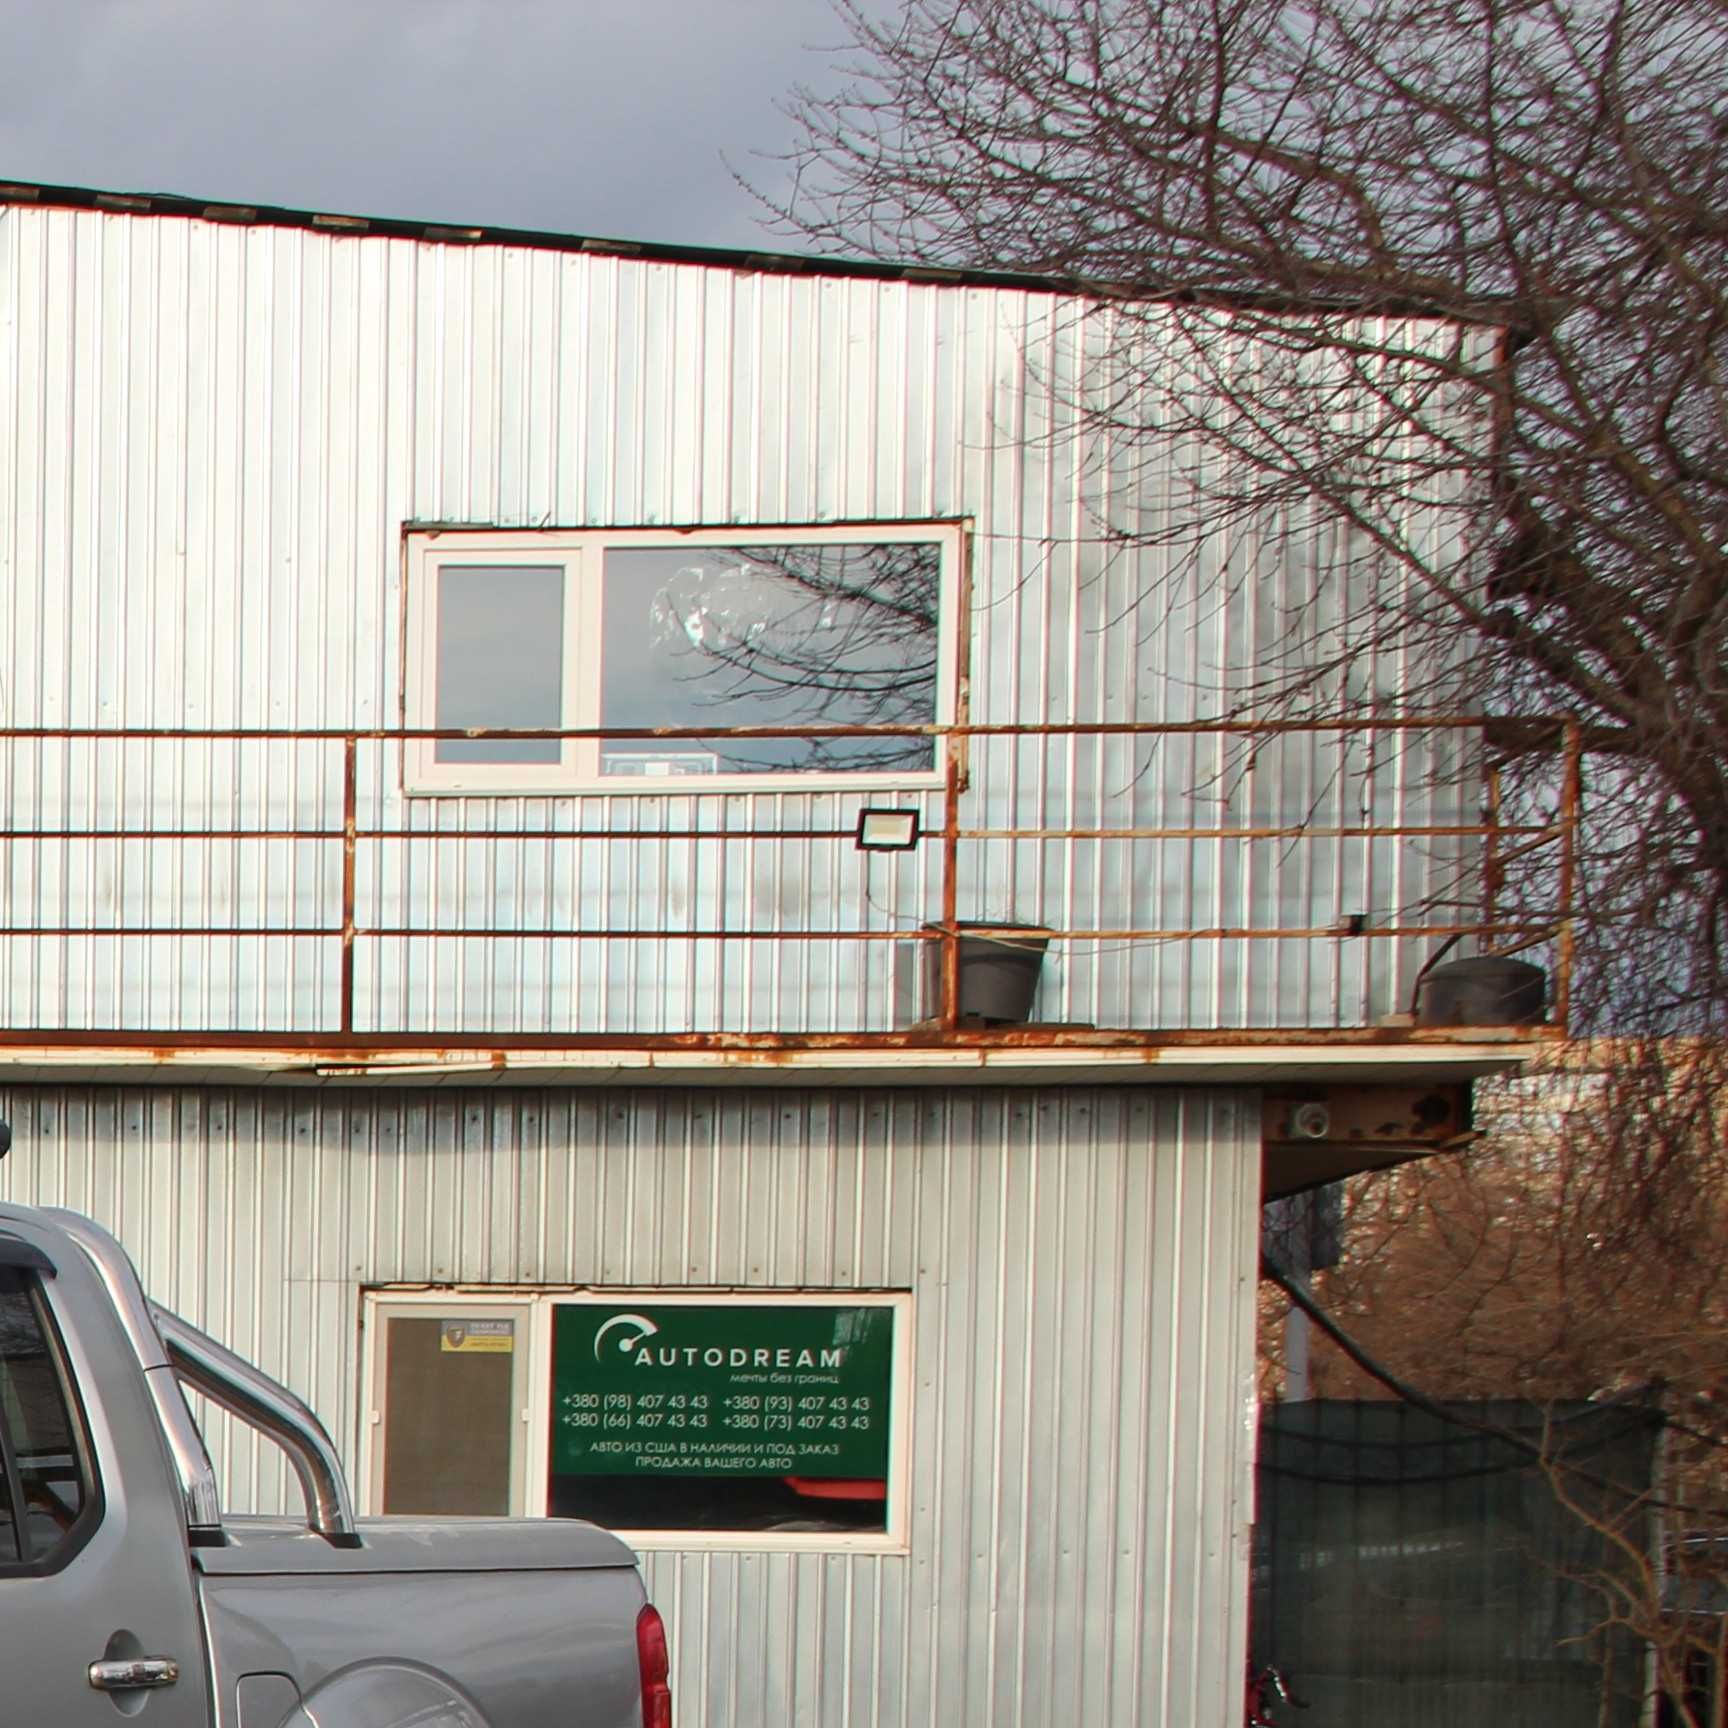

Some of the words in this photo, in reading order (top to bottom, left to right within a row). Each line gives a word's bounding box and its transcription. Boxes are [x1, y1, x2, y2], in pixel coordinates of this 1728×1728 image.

[634, 1348, 842, 1368] AUTODREAM
[730, 1374, 768, 1383] мечты
[770, 1372, 793, 1383] без
[794, 1374, 840, 1385] границ
[562, 1394, 599, 1408] +380
[603, 1394, 632, 1410] (98)
[636, 1394, 664, 1408] 407
[667, 1394, 686, 1408] 43
[689, 1394, 708, 1408] 43
[723, 1396, 760, 1410] +380
[764, 1396, 793, 1412] (93)
[797, 1396, 825, 1410] 407
[828, 1396, 848, 1410] 43
[851, 1396, 870, 1410] 43
[562, 1413, 599, 1427] +380
[603, 1413, 631, 1429] (66)
[636, 1413, 663, 1427] 407
[667, 1413, 686, 1427] 43
[689, 1413, 708, 1427] 43
[722, 1415, 760, 1429] +380
[763, 1415, 792, 1431] (73)
[797, 1415, 824, 1429] 407
[828, 1415, 847, 1429] 43
[850, 1415, 870, 1429] 43
[590, 1442, 623, 1453] АВТО
[625, 1442, 642, 1453] ИЗ
[645, 1442, 676, 1453] США
[680, 1442, 688, 1453] В
[690, 1443, 752, 1454] НАЛИЧИИ
[754, 1444, 763, 1454] И
[766, 1444, 796, 1455] ПОД
[799, 1444, 840, 1455] ЗАКАЗ
[635, 1456, 702, 1468] ПРОДАЖА
[704, 1457, 756, 1469] ВАШЕГО
[759, 1458, 793, 1469] АВТО
